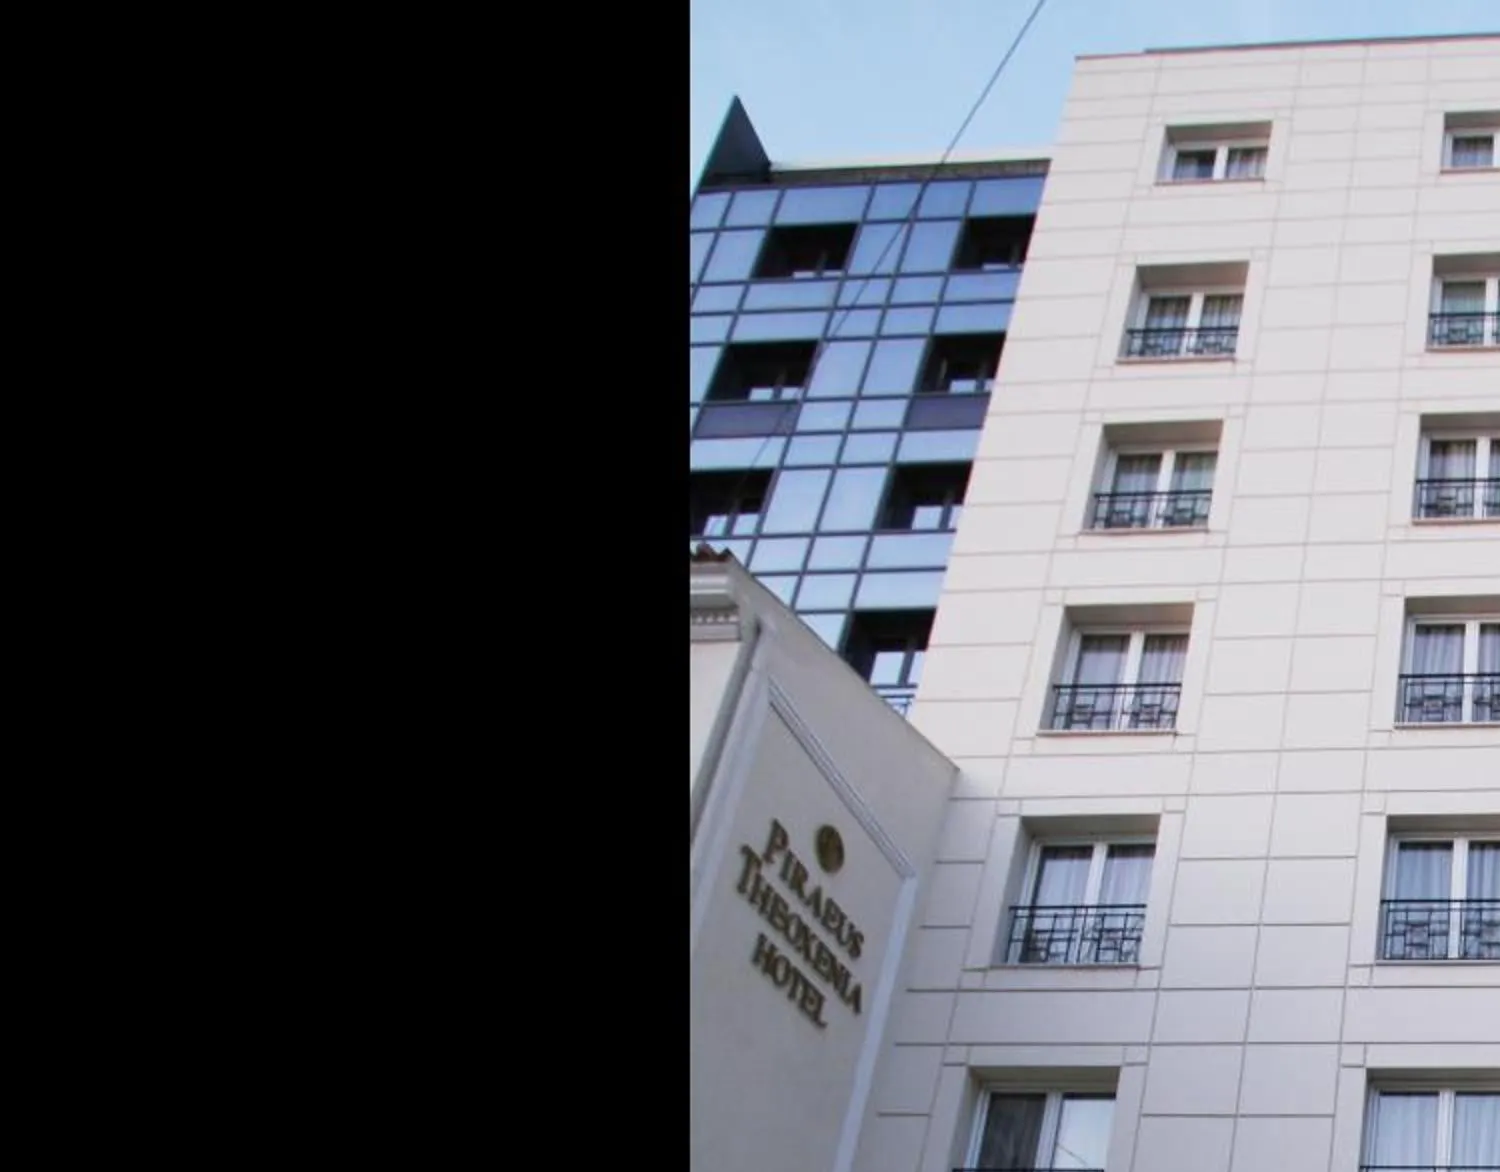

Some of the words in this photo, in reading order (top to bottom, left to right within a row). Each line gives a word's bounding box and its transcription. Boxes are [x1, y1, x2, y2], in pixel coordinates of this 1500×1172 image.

[736, 844, 862, 1014] THEOXENIA
[762, 819, 864, 960] PIRAEUS
[752, 932, 828, 1029] HOTEL
